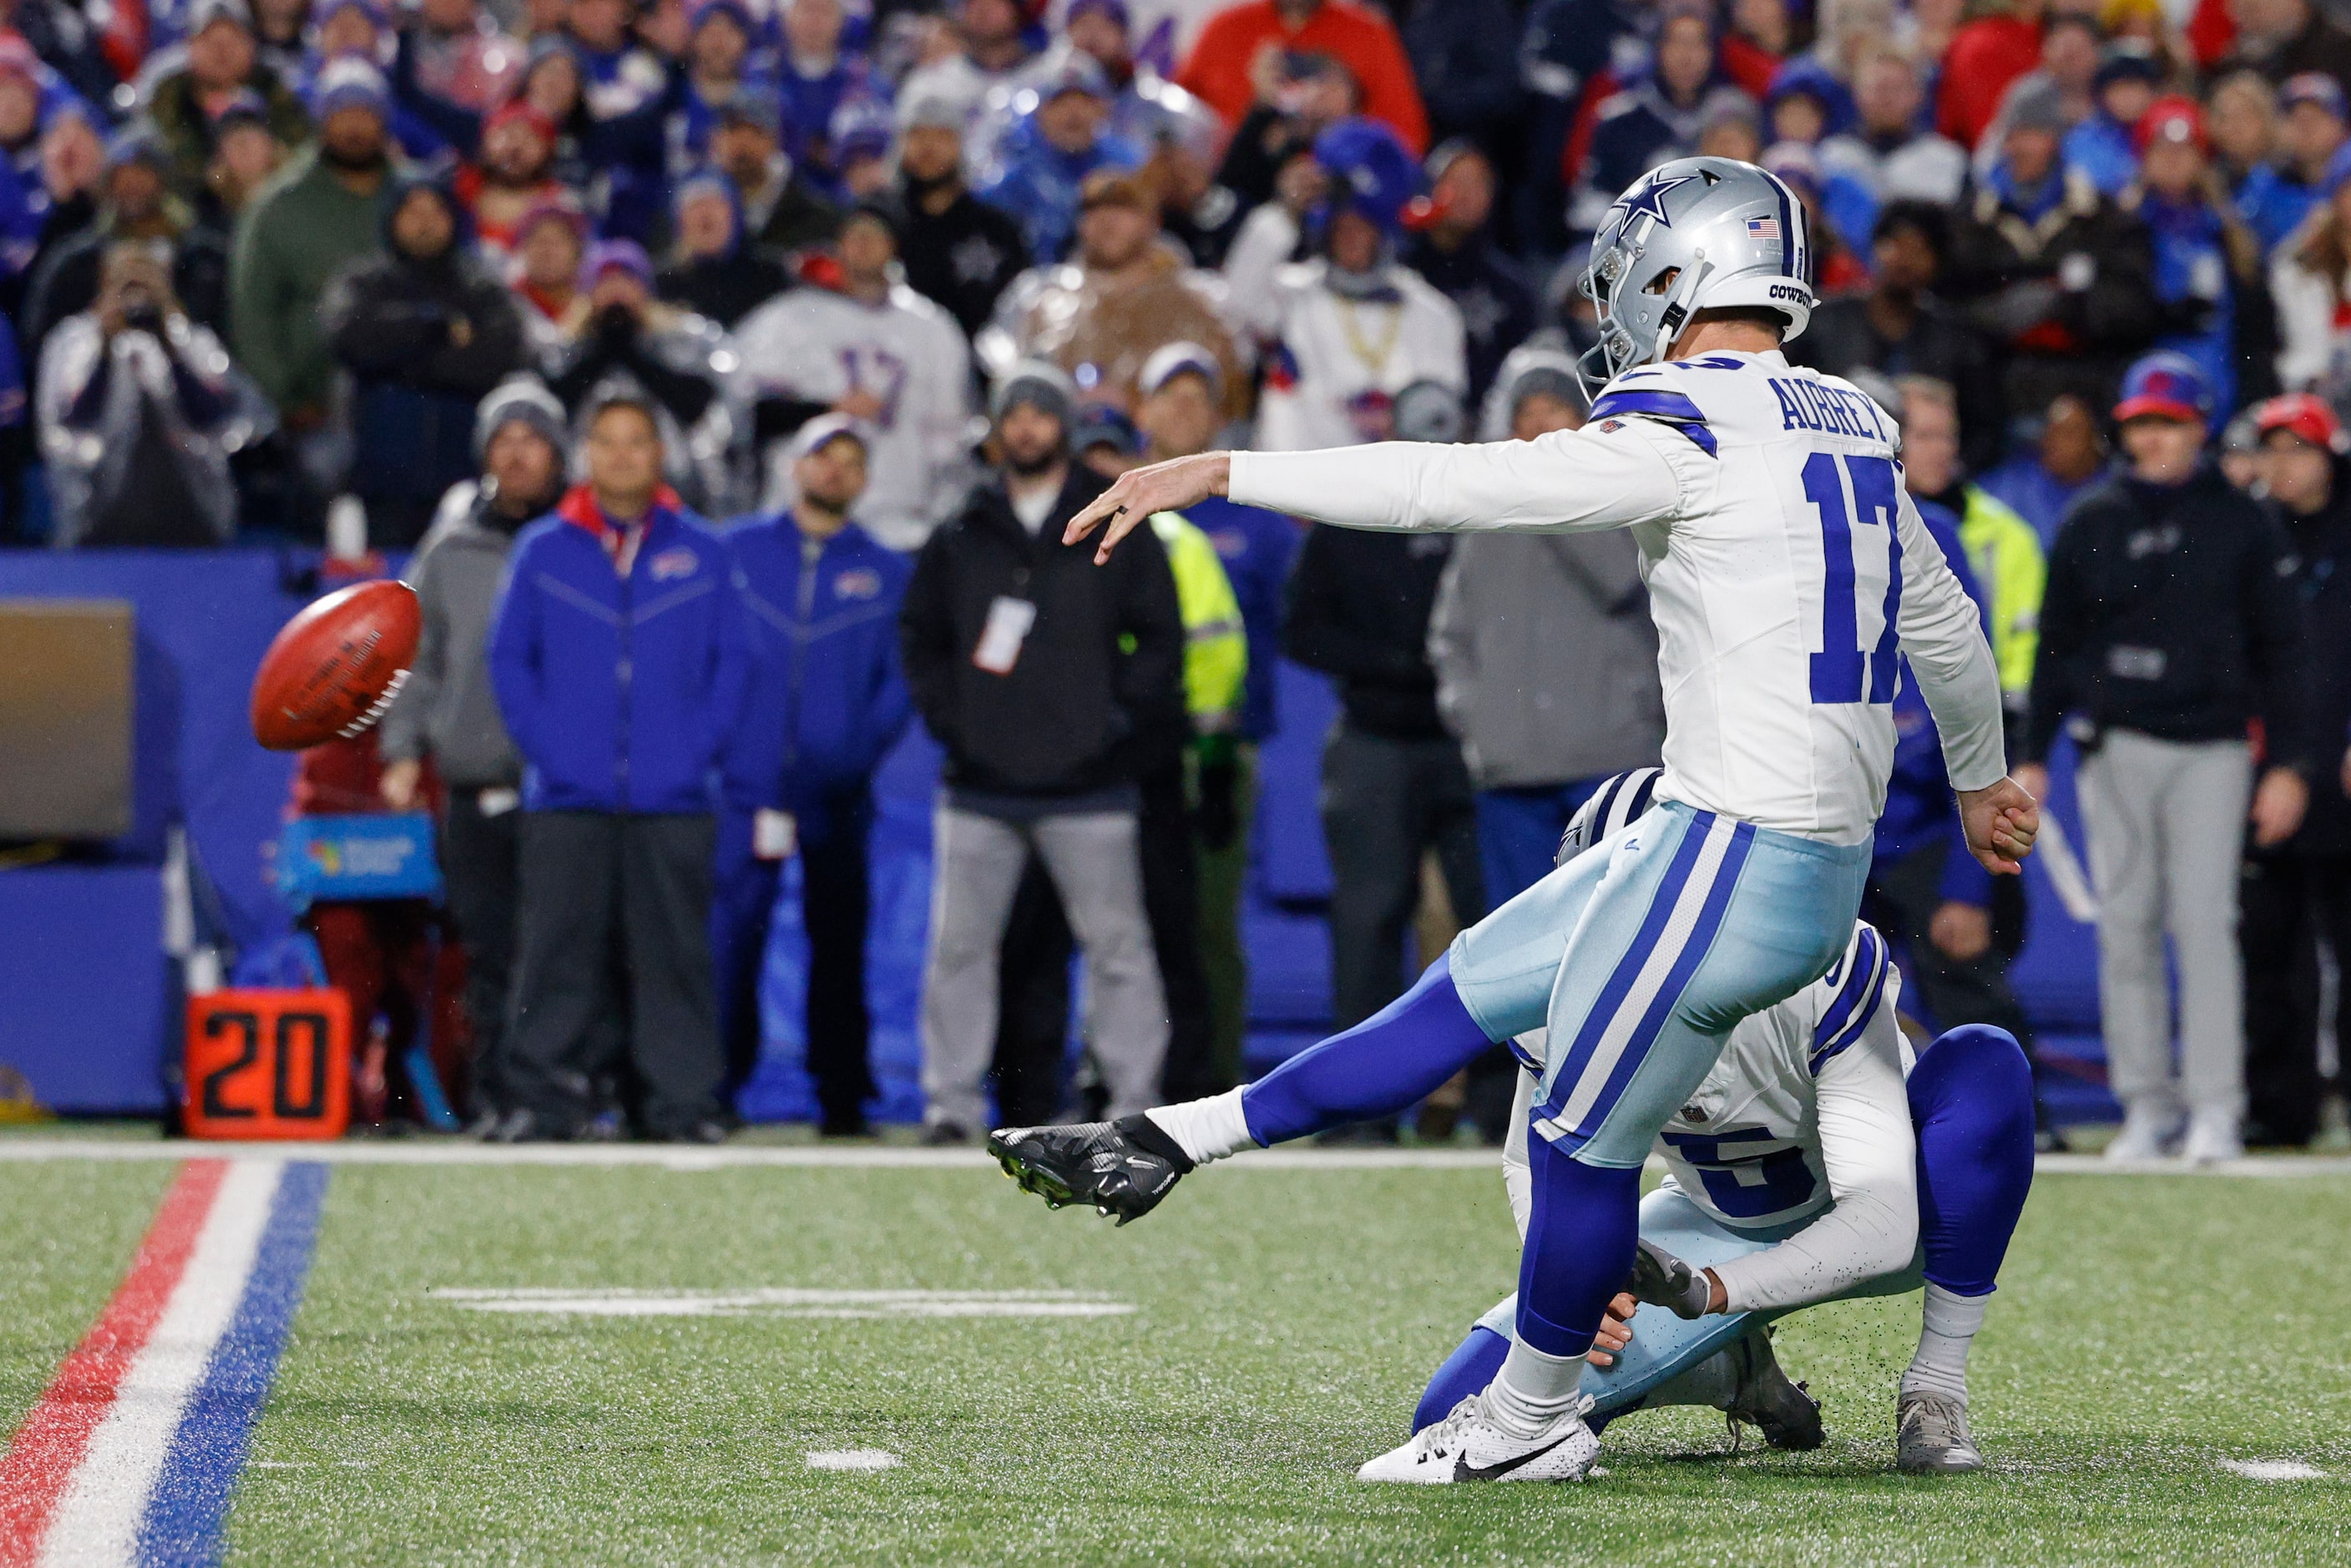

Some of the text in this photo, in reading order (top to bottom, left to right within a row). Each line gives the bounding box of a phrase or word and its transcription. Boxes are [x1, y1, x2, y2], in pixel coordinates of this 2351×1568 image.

[1767, 377, 1888, 443] AUBREY
[1801, 452, 1904, 704] 17
[204, 1012, 327, 1117] 20
[1660, 1126, 1817, 1217] 5
